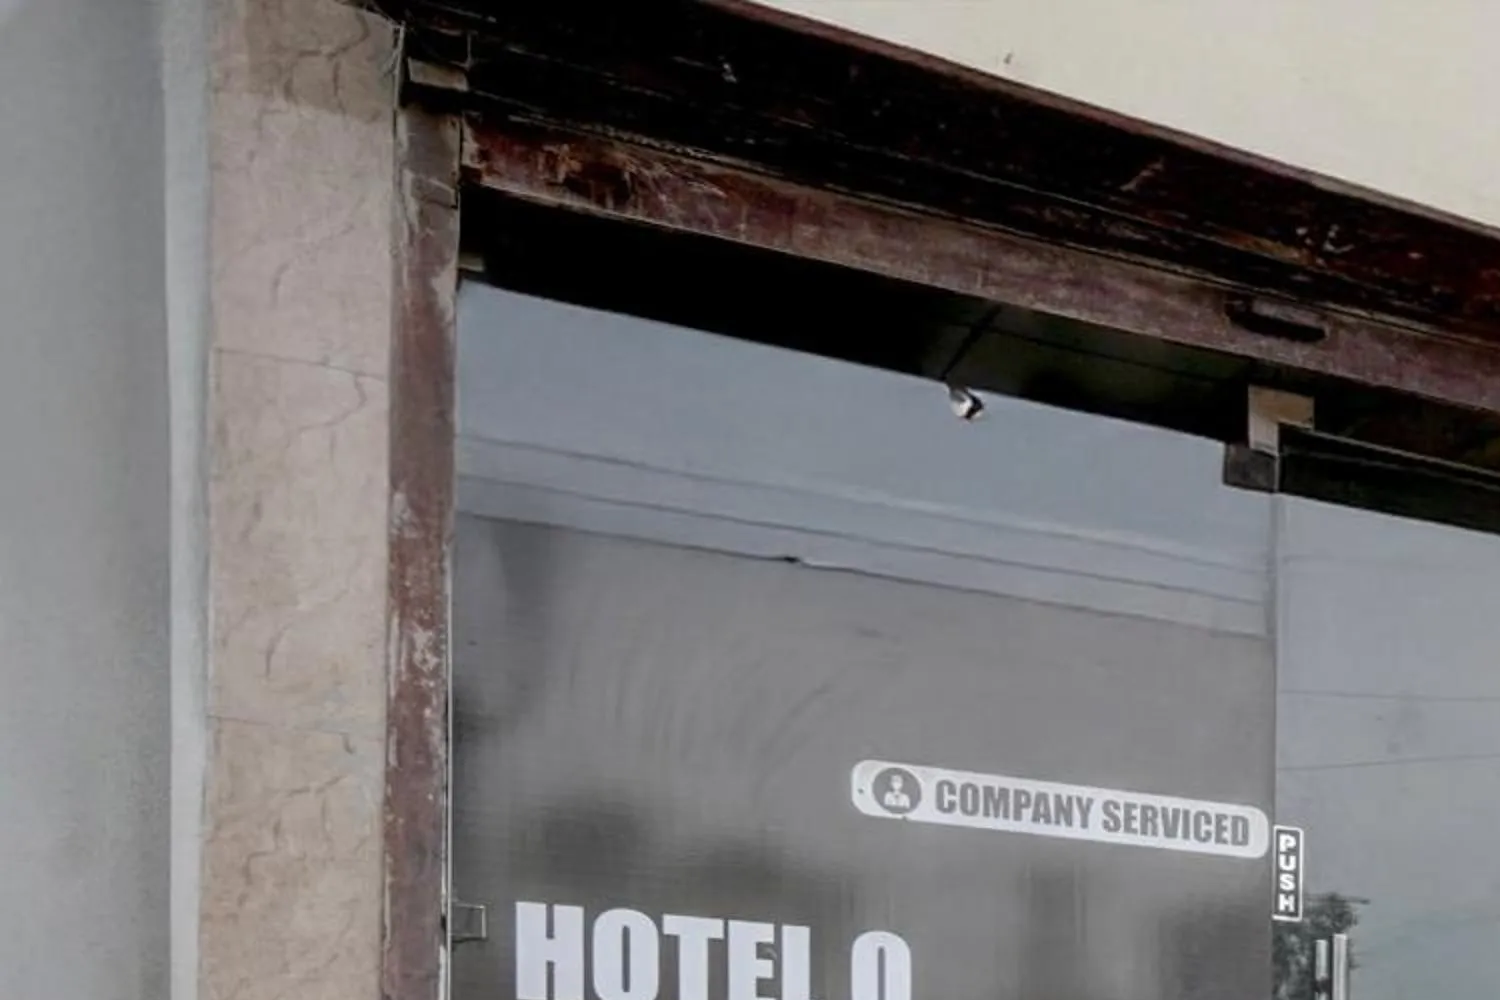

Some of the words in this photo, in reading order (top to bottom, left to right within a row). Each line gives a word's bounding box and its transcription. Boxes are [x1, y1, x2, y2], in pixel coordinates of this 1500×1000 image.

[935, 779, 1094, 829] COMPANY
[1101, 799, 1250, 847] SERVICED
[1278, 833, 1297, 913] PUSH
